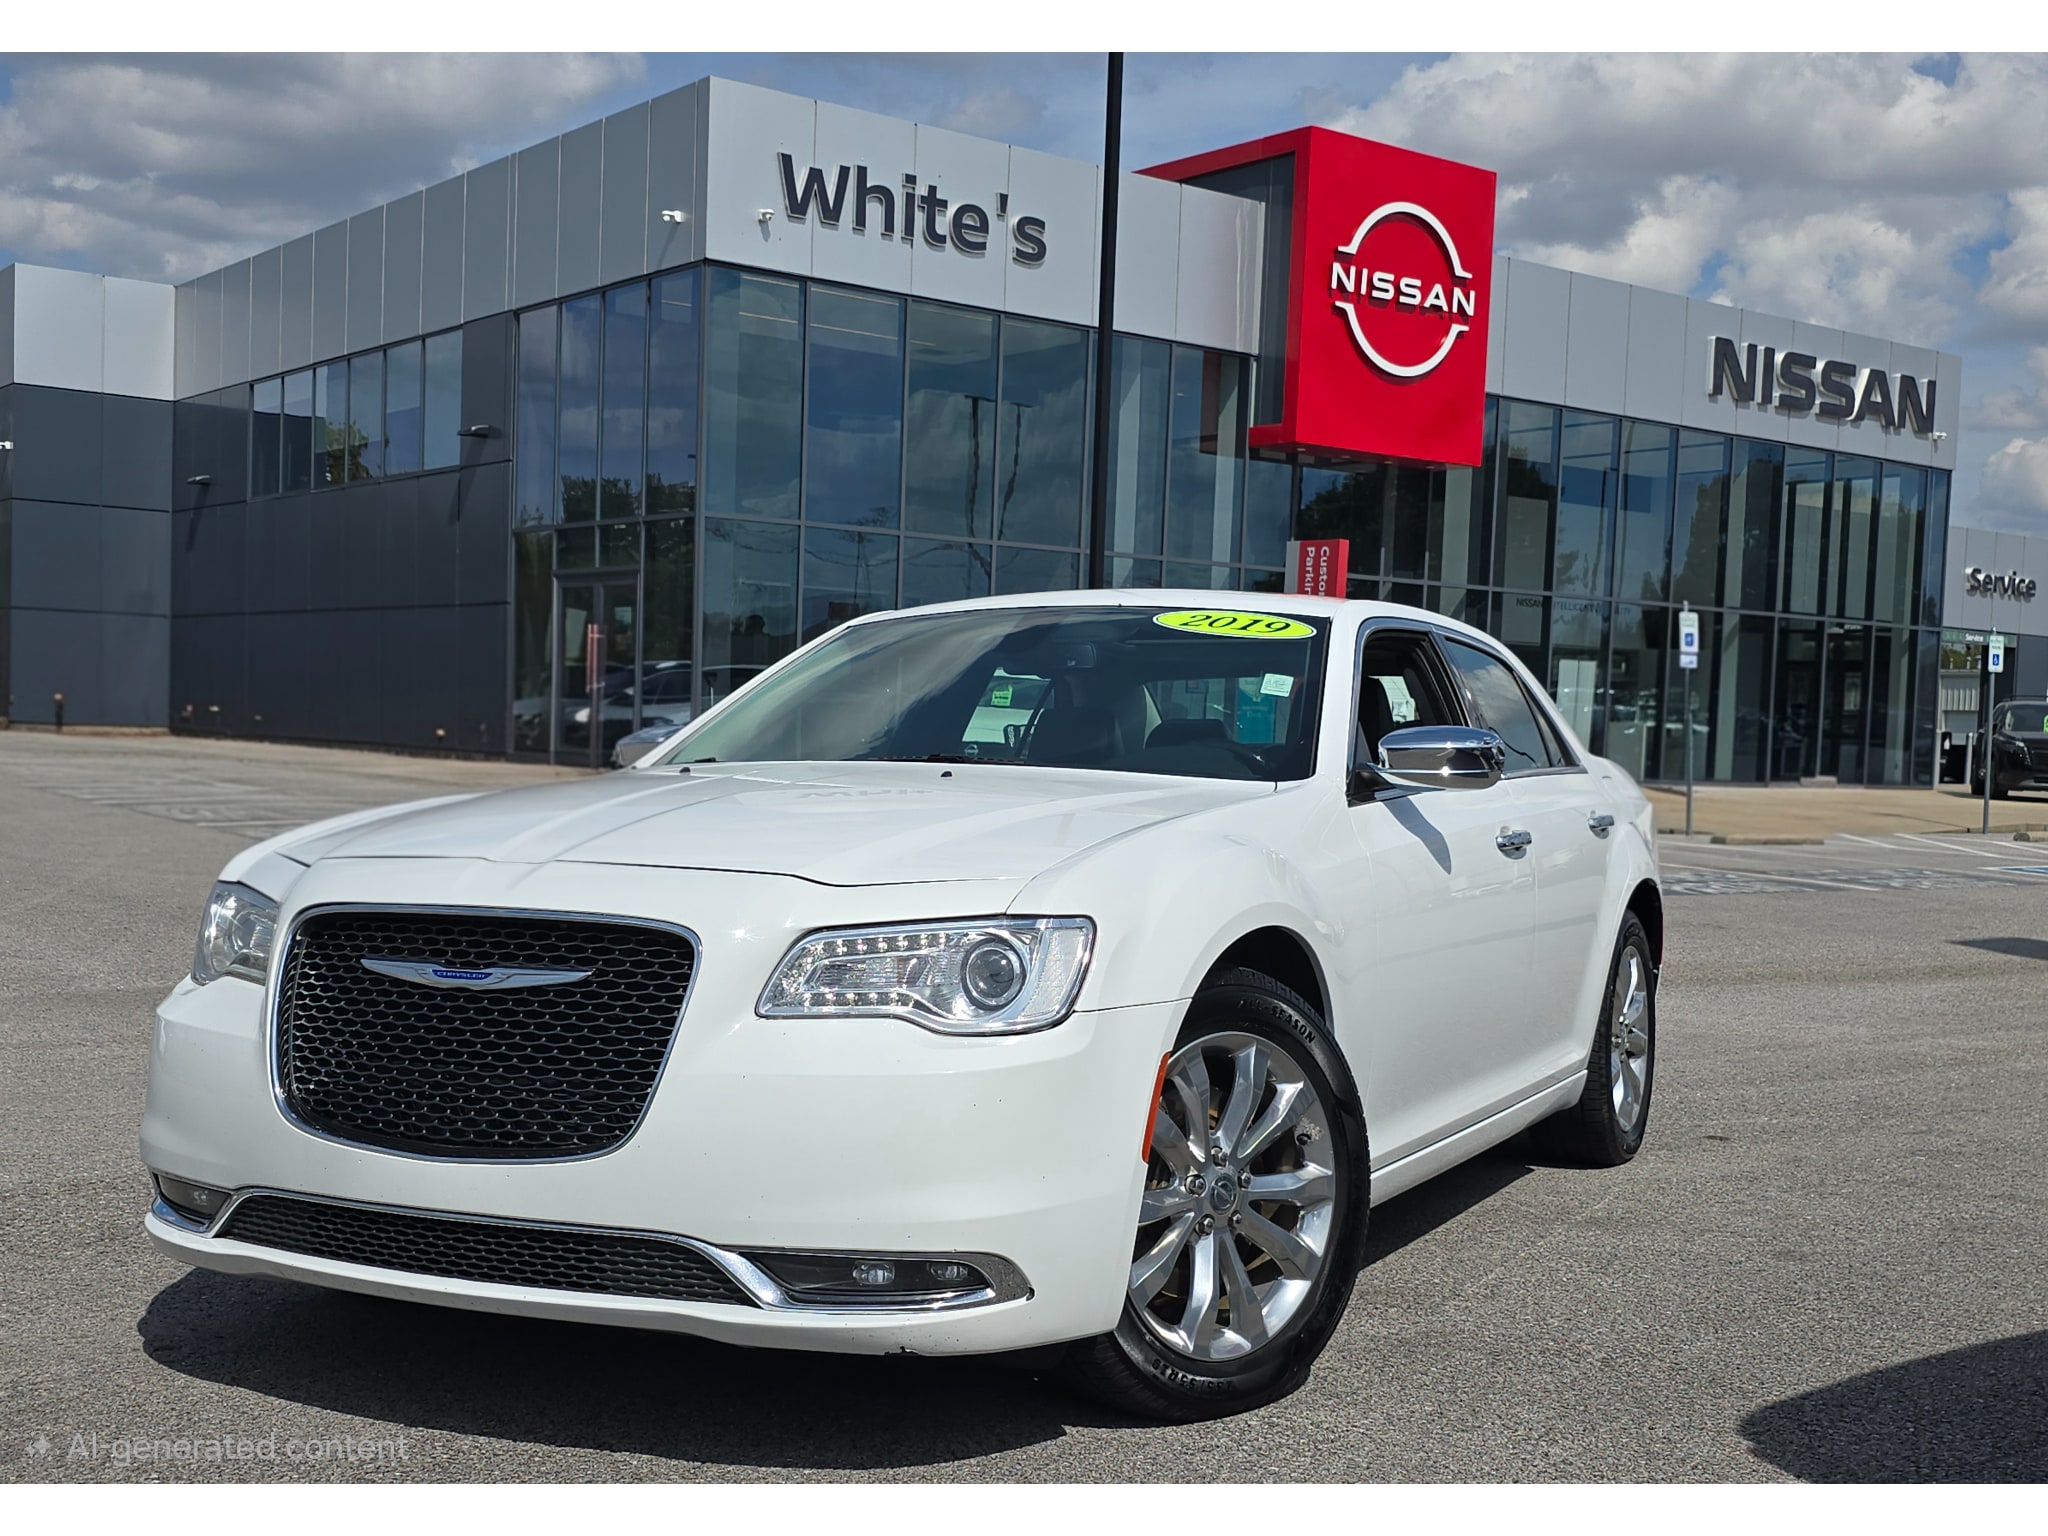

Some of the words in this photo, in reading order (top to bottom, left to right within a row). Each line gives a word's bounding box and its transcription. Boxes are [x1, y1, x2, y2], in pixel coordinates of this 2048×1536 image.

[777, 152, 1047, 264] White's
[1331, 262, 1475, 316] NISSAN
[1708, 336, 1936, 433] NISSAN
[1965, 567, 2037, 598] Service
[1179, 614, 1291, 633] 2019
